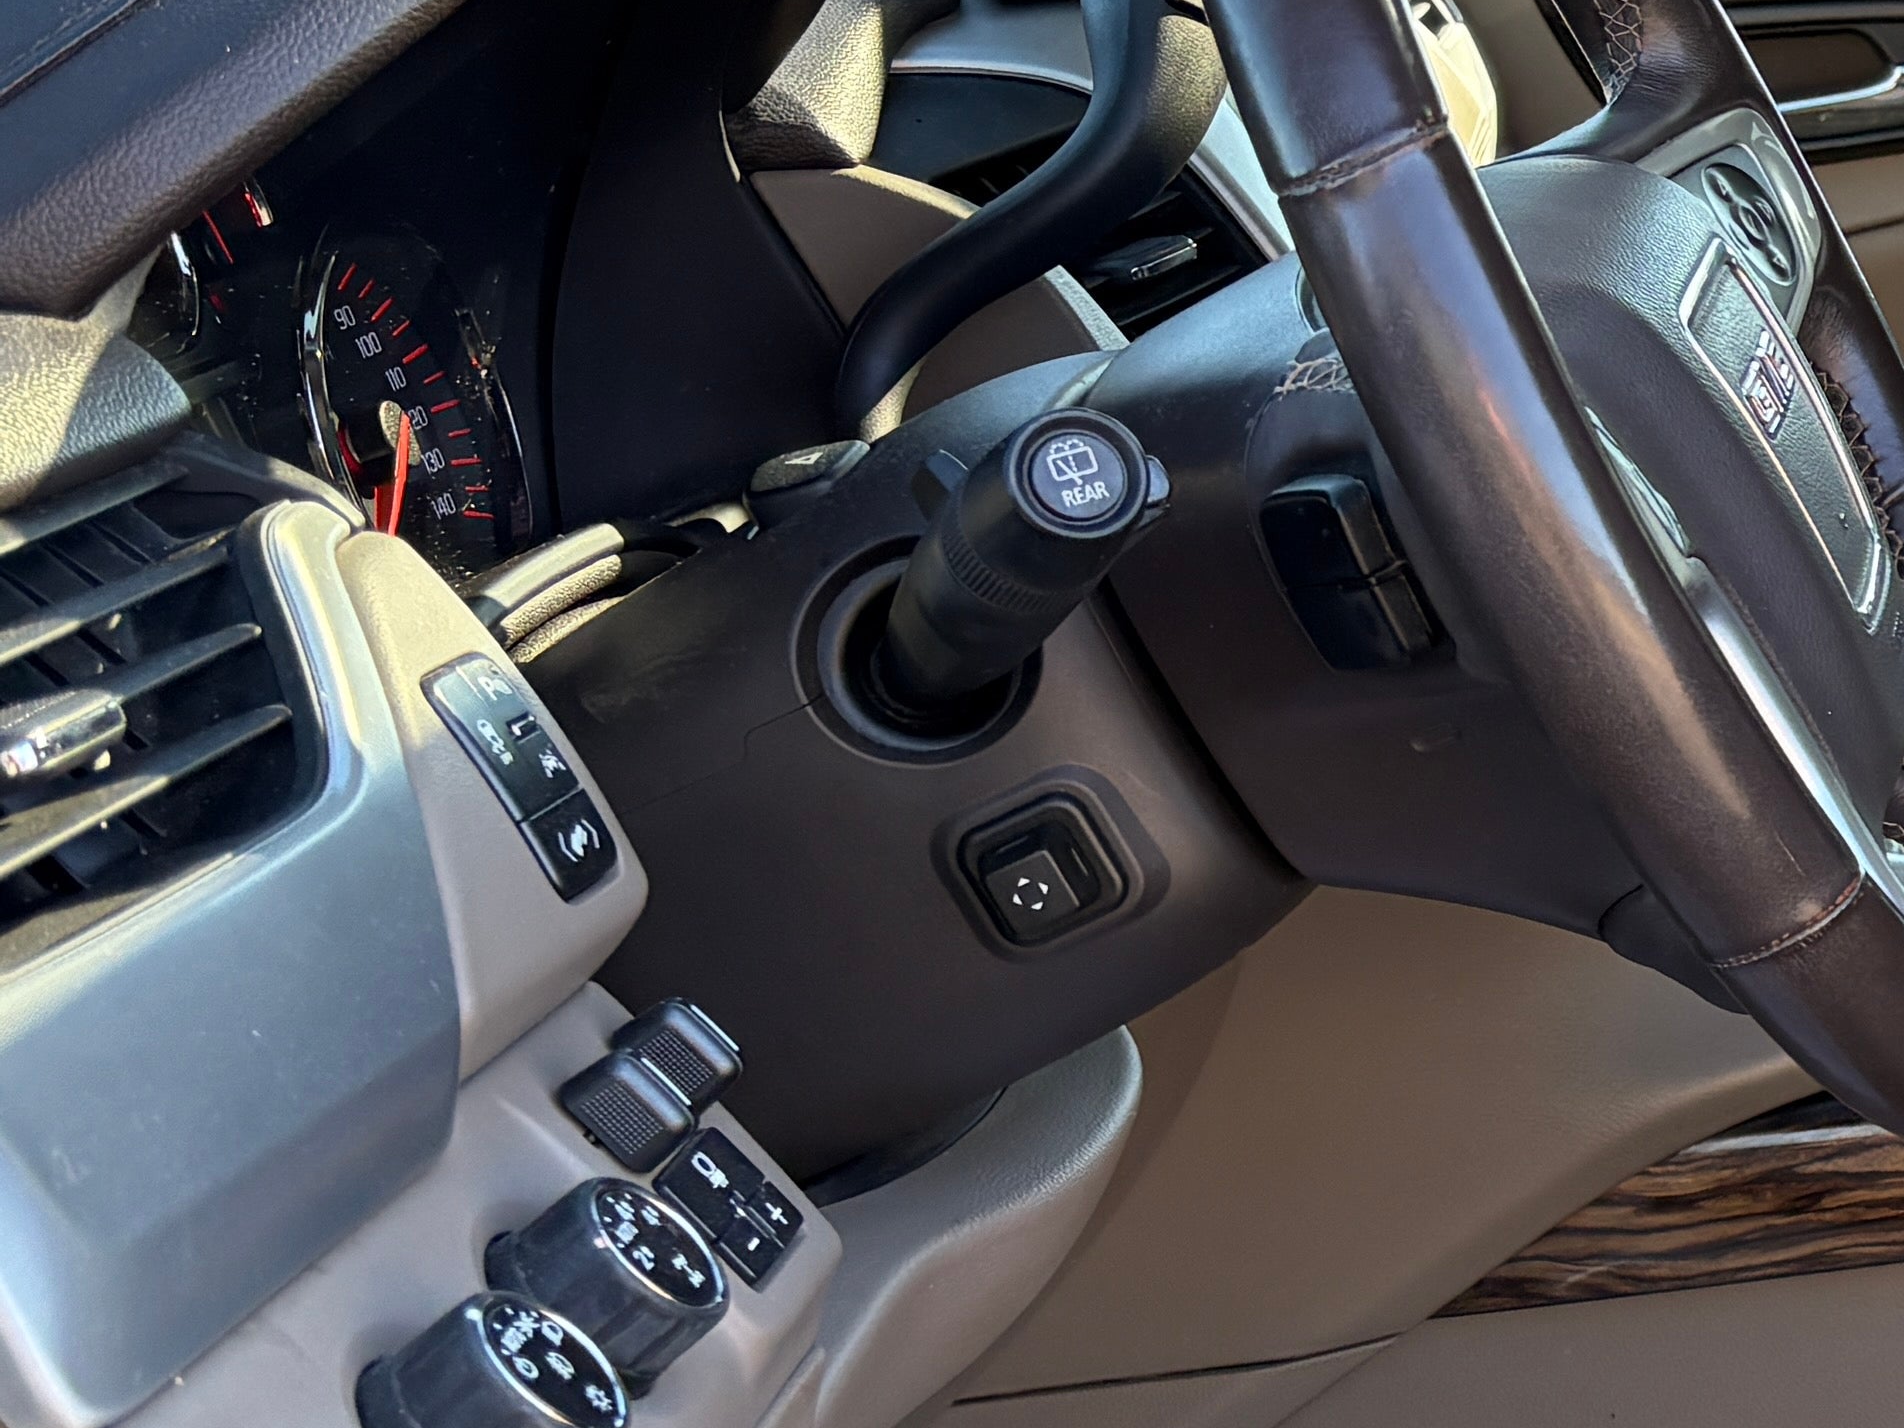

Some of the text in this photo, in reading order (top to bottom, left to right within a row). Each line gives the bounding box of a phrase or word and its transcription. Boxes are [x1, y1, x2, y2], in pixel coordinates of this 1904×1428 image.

[334, 305, 355, 330] 90
[355, 332, 382, 359] 100
[385, 366, 407, 391] 110
[408, 406, 428, 430] 20
[420, 448, 445, 473] 130
[431, 493, 456, 519] 140
[1061, 481, 1110, 507] REAR
